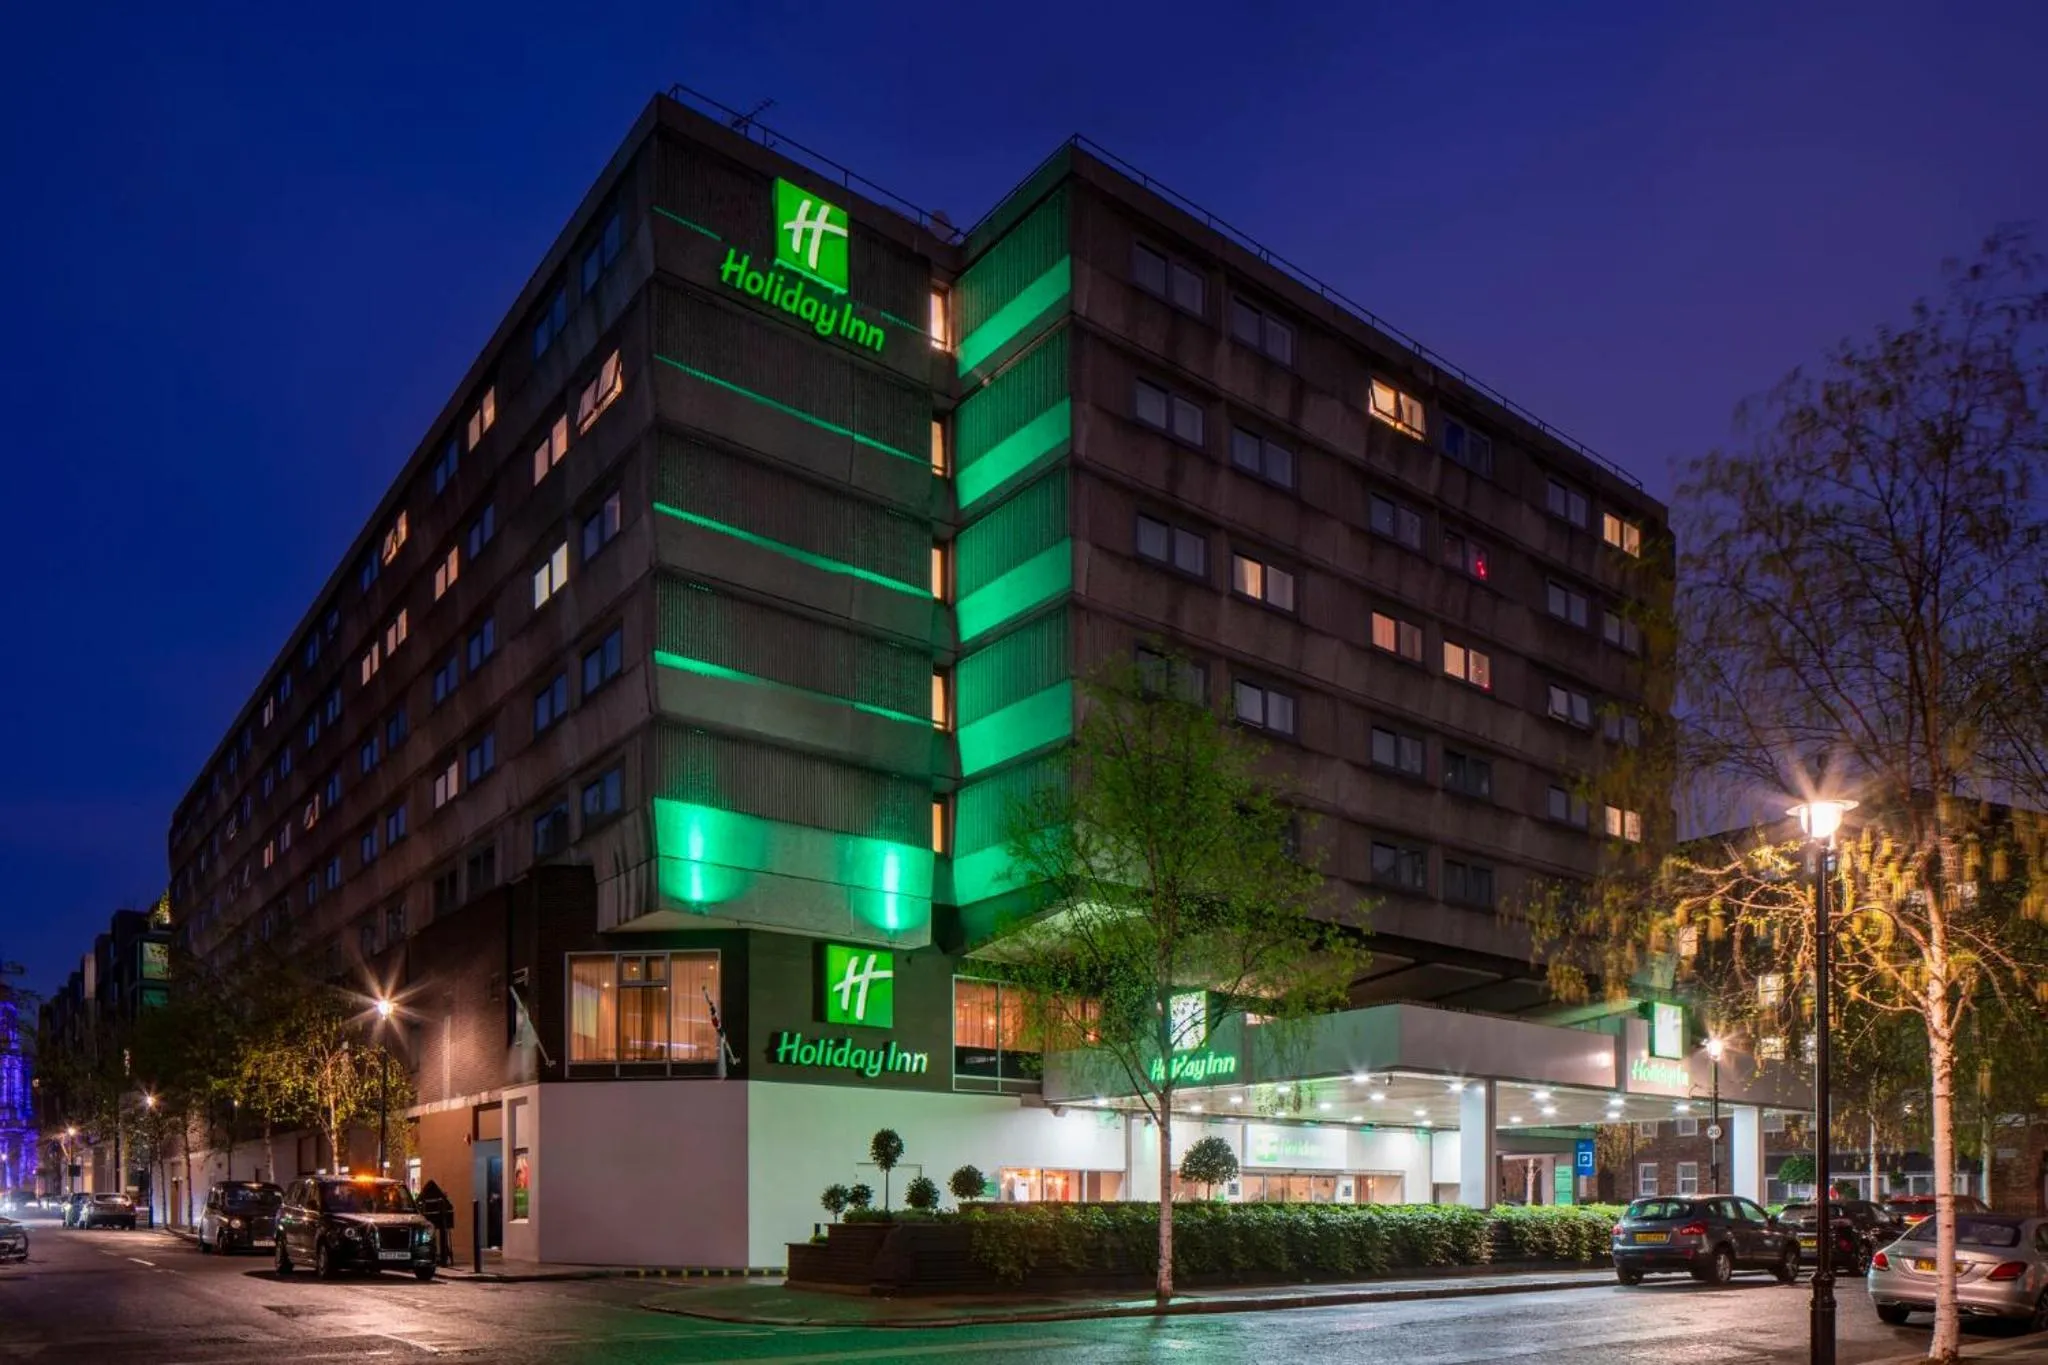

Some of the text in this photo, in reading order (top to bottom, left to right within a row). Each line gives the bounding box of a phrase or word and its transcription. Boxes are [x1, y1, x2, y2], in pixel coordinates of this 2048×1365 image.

[720, 248, 886, 352] Holiday Inn
[776, 1031, 929, 1077] Holiday Inn
[1150, 1051, 1236, 1081] Hday Inn
